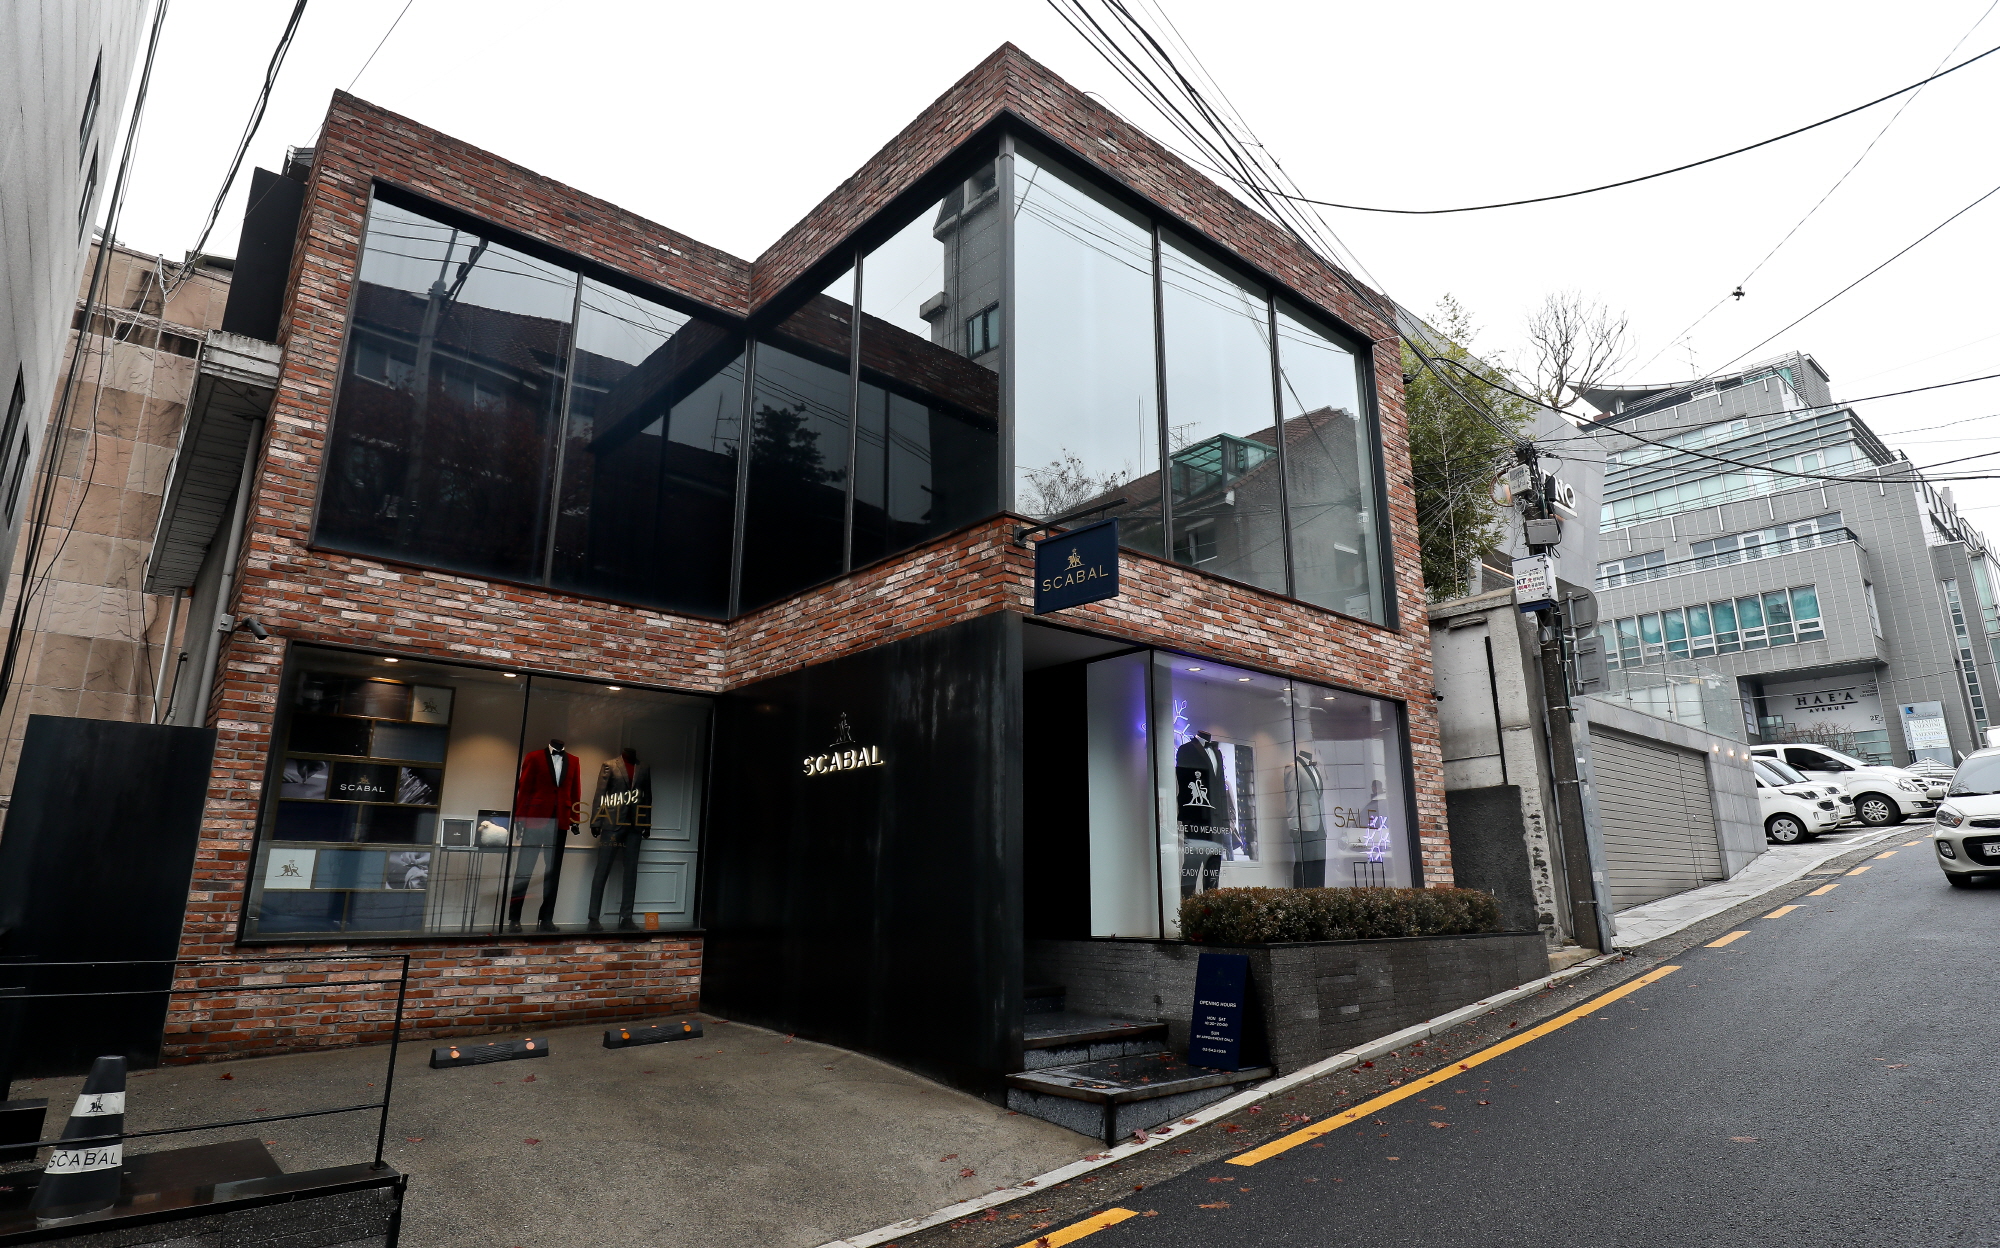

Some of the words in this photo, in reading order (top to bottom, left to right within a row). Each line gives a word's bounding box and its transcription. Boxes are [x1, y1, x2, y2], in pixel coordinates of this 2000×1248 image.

[1042, 565, 1109, 592] SCABAL
[1516, 578, 1527, 586] KT
[1797, 691, 1854, 706] HAE'A
[1809, 705, 1846, 713] AVENUE
[802, 745, 885, 776] SCABAL
[339, 783, 386, 793] SCABAL
[569, 801, 653, 827] SALE
[1333, 806, 1379, 830] SALE
[1190, 825, 1199, 833] TO
[1200, 826, 1229, 834] MEASURE
[1205, 847, 1227, 856] ORDER
[48, 1152, 118, 1169] SCABAL
